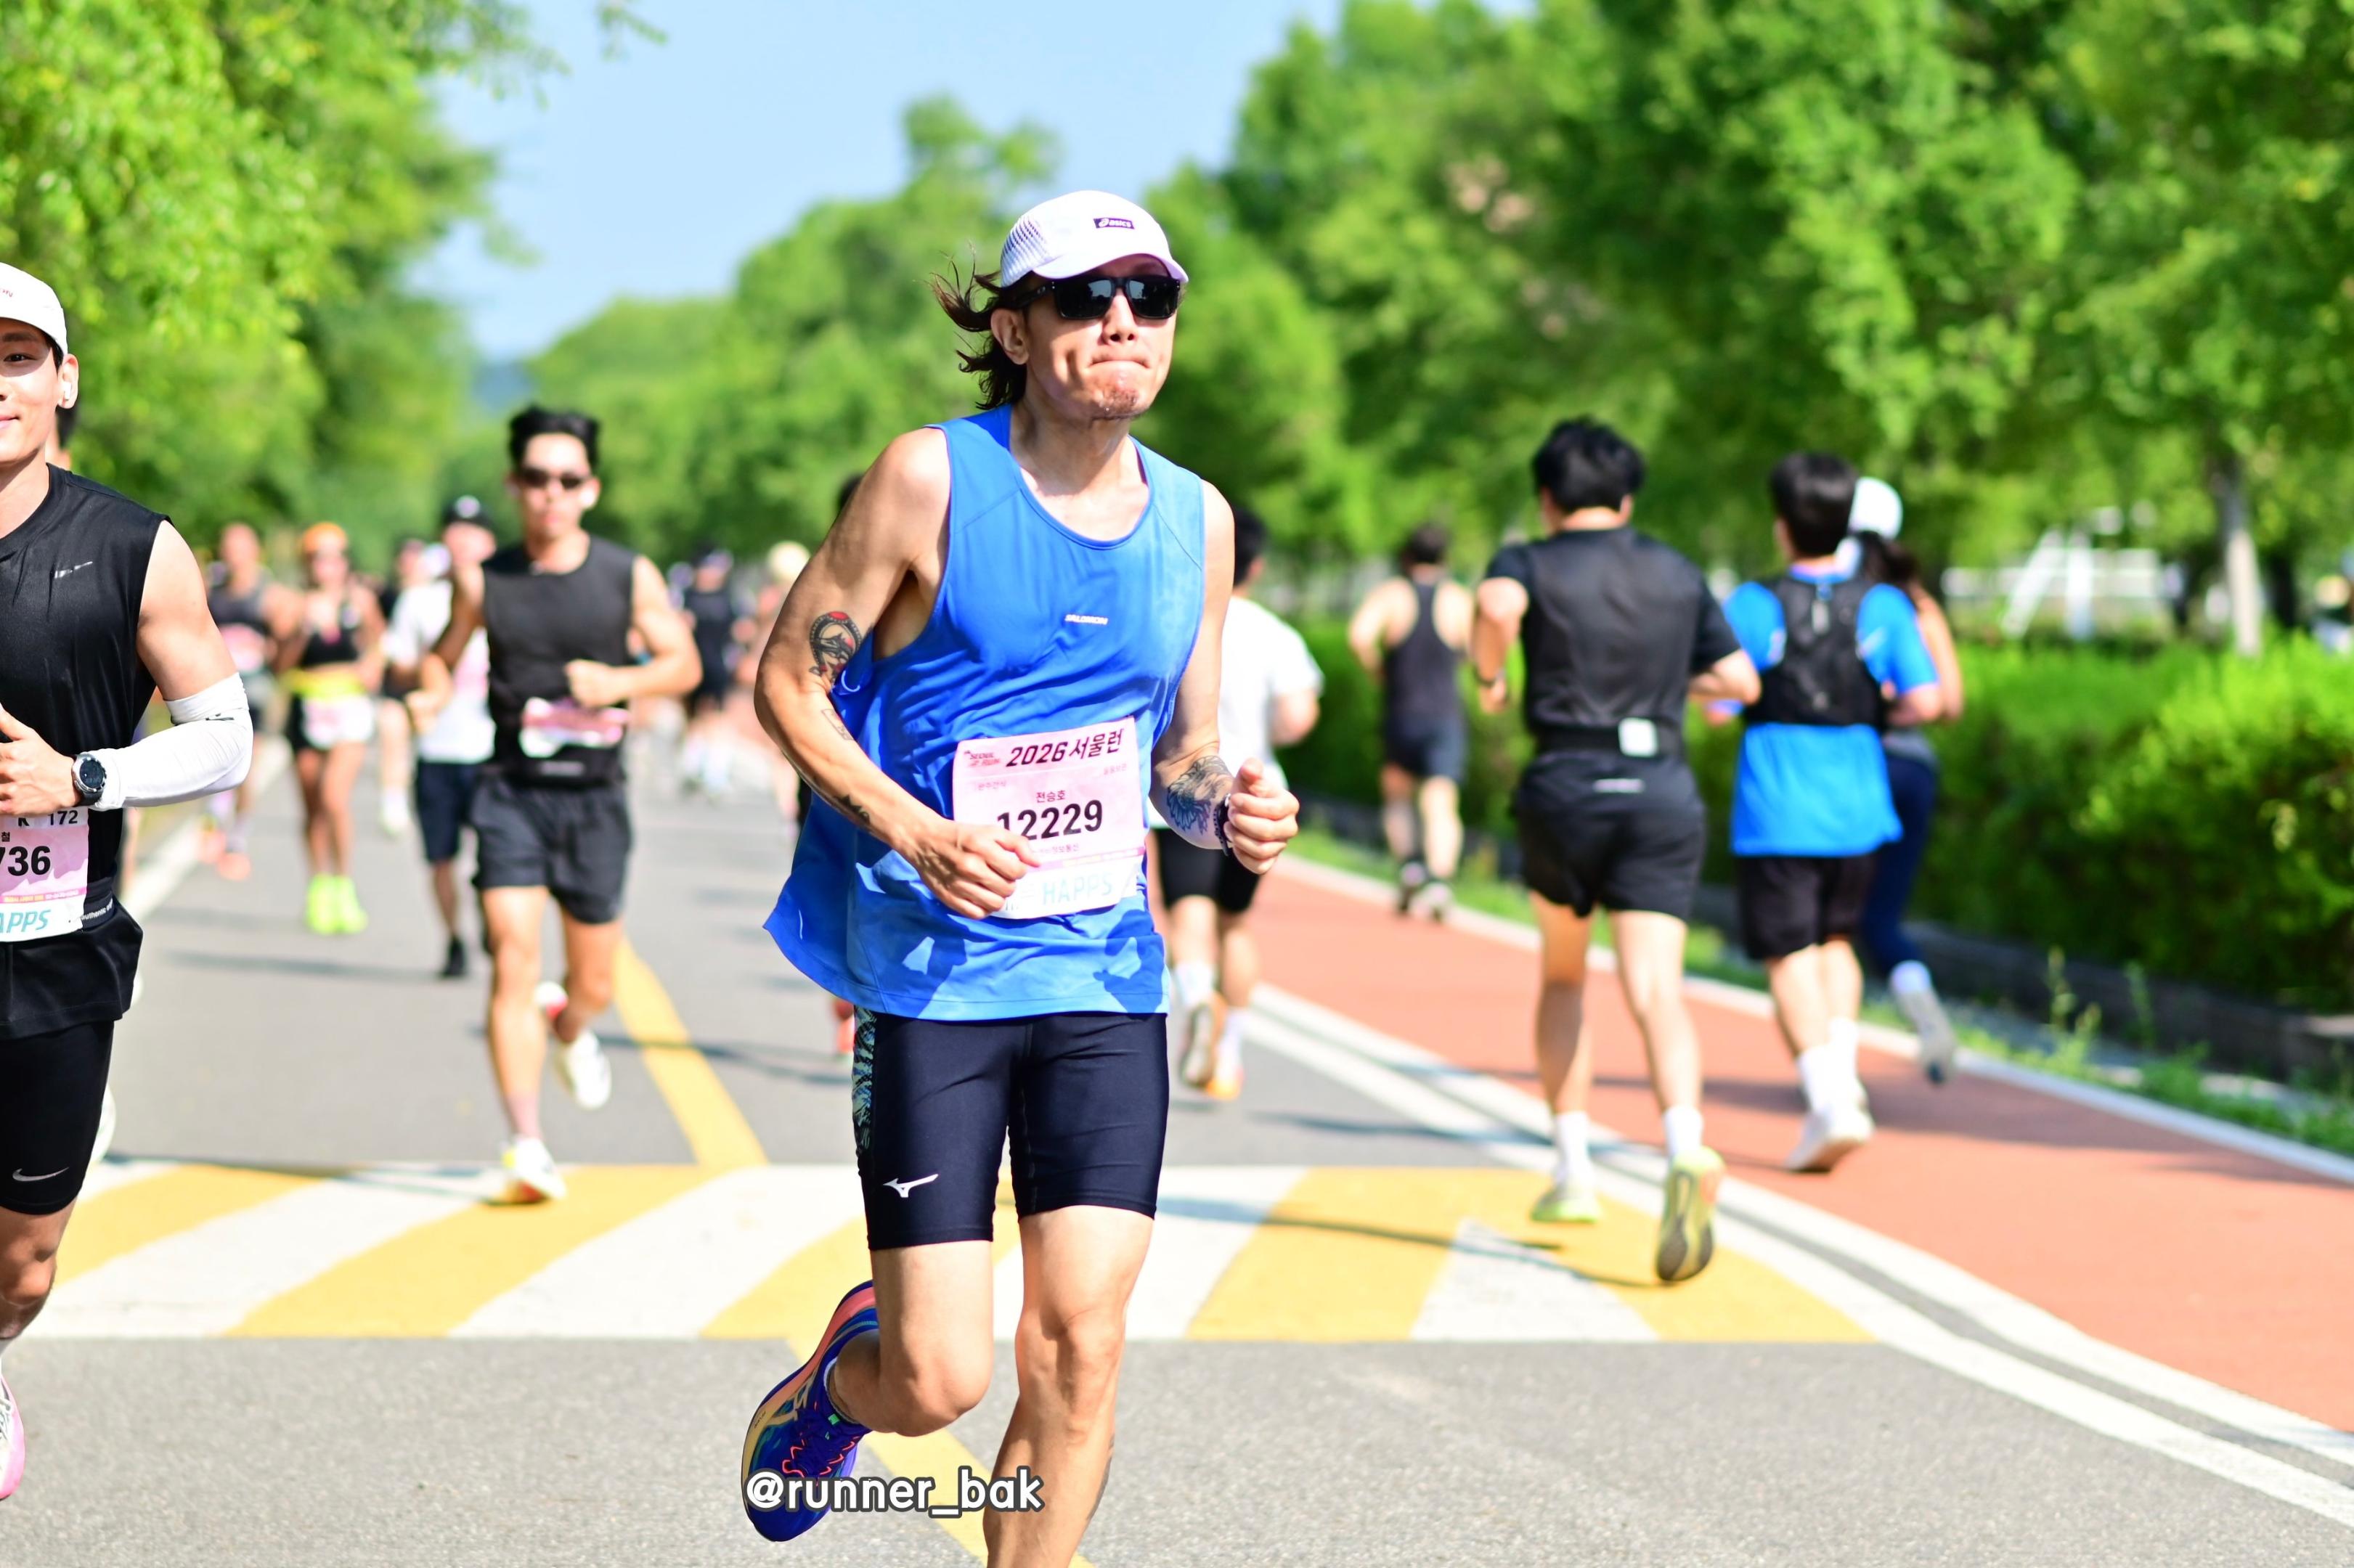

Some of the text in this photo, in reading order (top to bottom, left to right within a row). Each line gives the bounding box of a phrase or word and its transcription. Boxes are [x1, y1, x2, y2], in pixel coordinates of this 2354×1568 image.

[1109, 219, 1131, 228] asics
[1006, 728, 1124, 767] 2026 서울런
[1036, 790, 1066, 804] 전승호
[48, 810, 78, 826] 172
[997, 799, 1103, 841] 12229
[0, 846, 51, 876] 36
[1043, 873, 1112, 905] HAPPS
[0, 910, 52, 934] PPS
